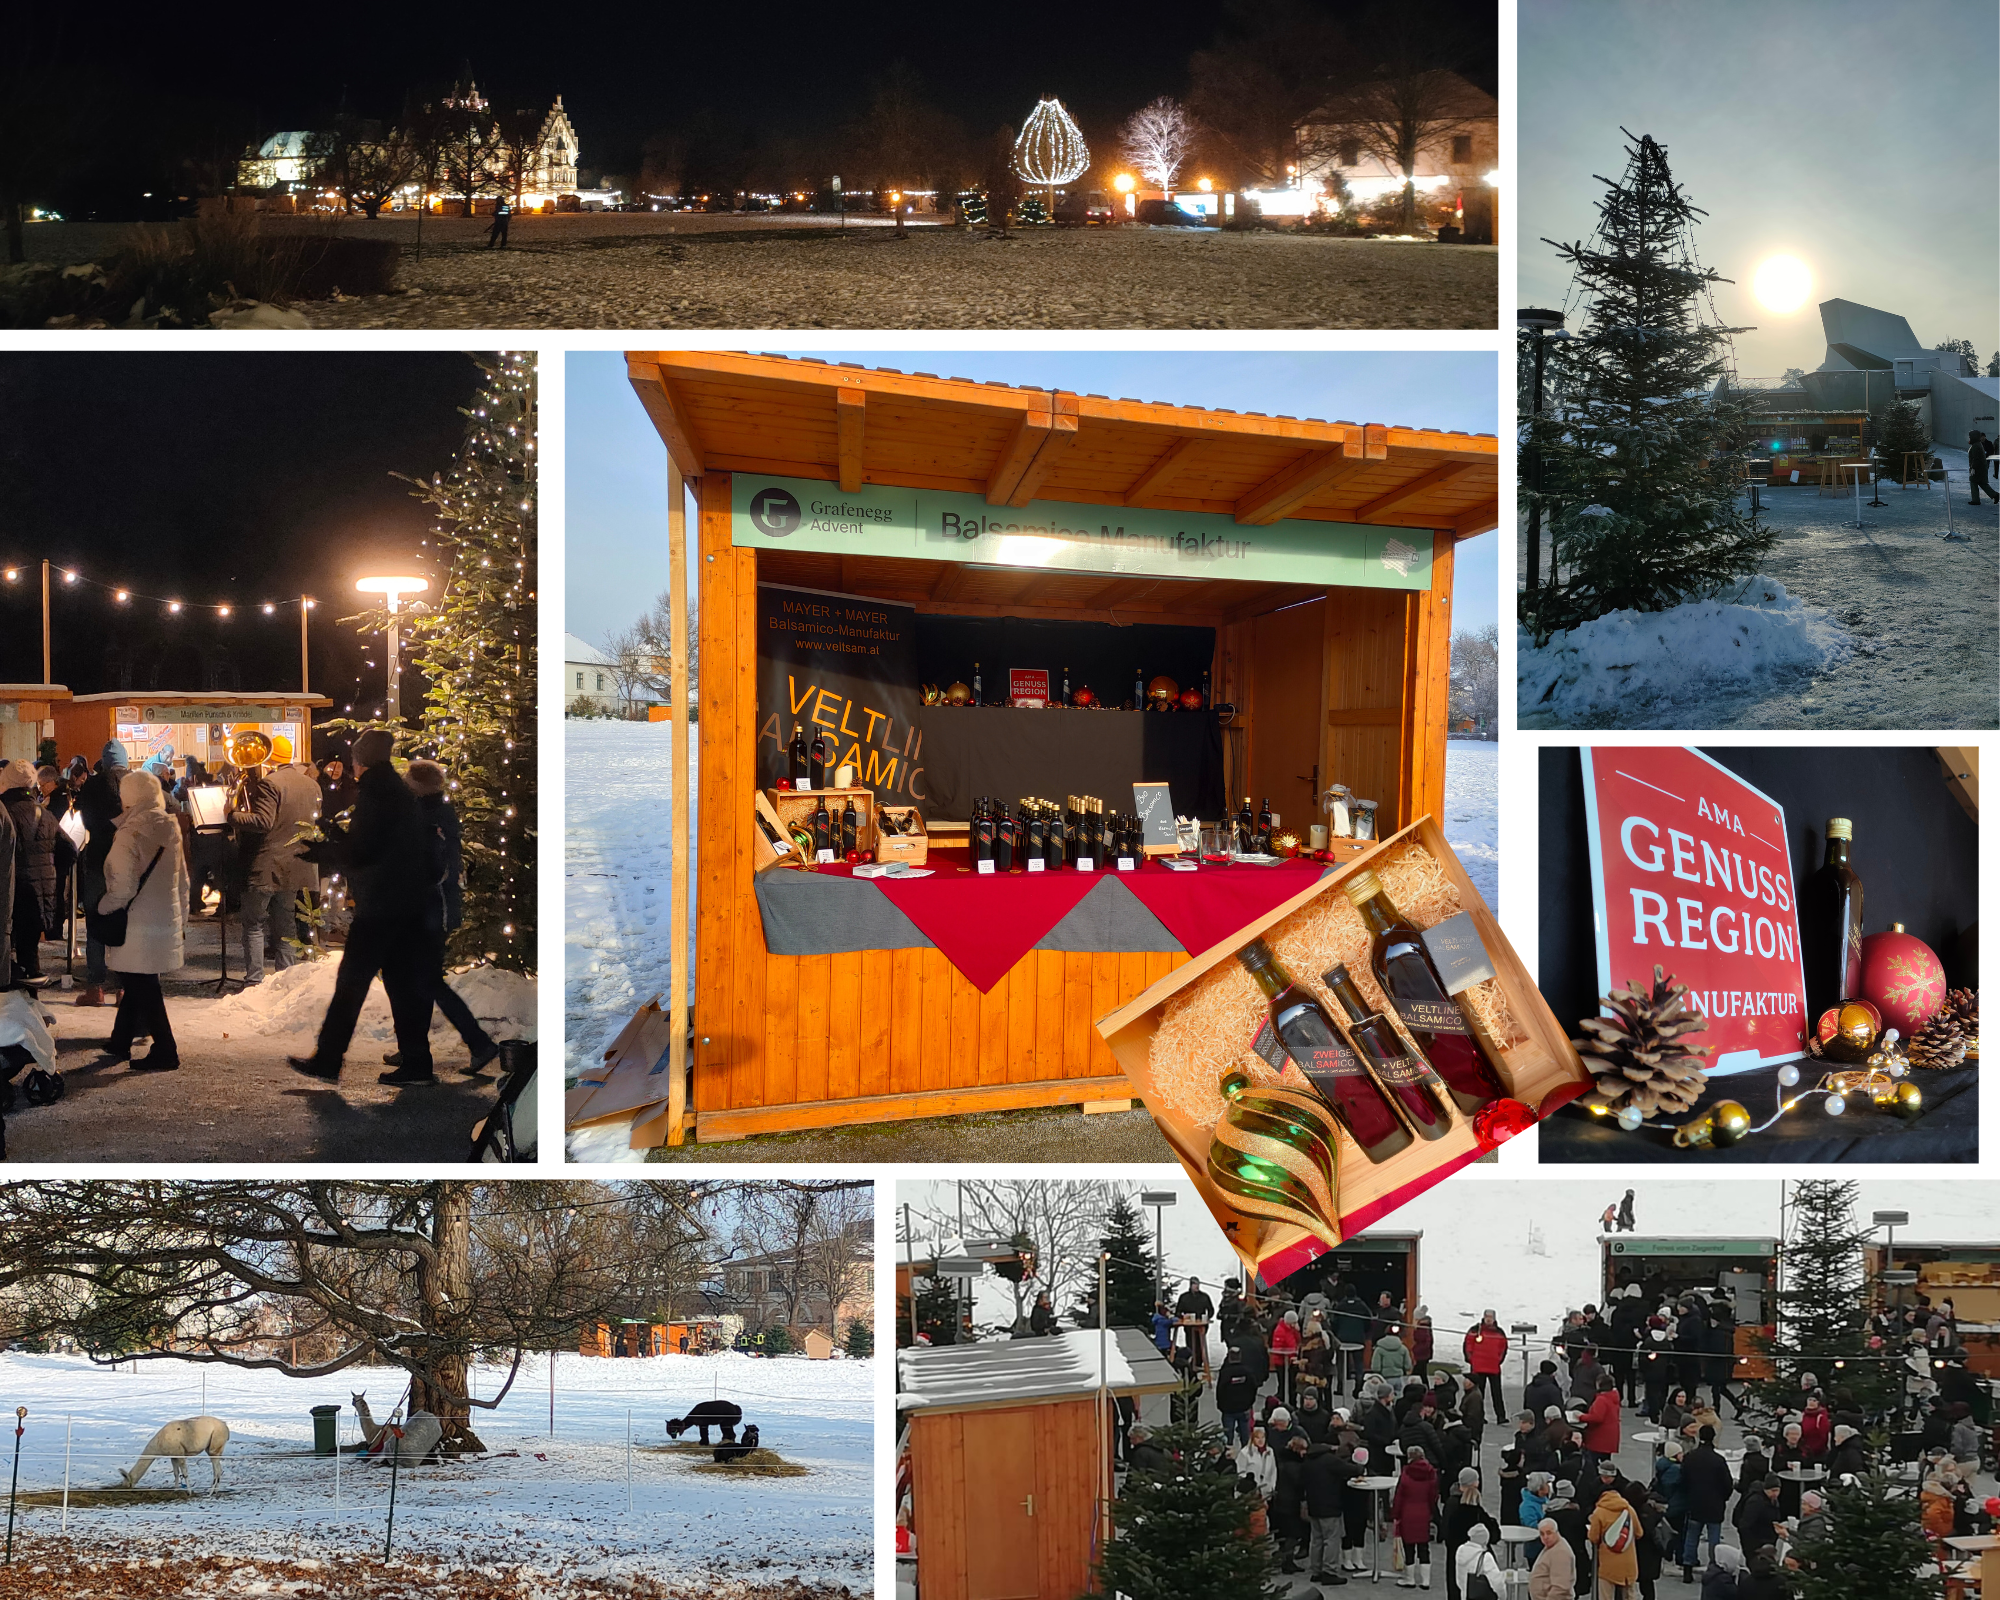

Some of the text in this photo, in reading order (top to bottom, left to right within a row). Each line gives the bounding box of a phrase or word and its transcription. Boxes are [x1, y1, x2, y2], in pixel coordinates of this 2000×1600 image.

[810, 500, 893, 523] Grafenegg
[810, 518, 864, 534] Advent
[1100, 525, 1251, 560] Manufaktur
[783, 600, 888, 625] MAYER + MAYER
[769, 616, 900, 642] Balsamico-Manufaktur
[795, 639, 880, 655] www.veltsam.at
[1013, 680, 1046, 688] GENUSS
[1697, 796, 1745, 837] AMA
[1620, 815, 1790, 912] GENUSS
[1629, 887, 1795, 963] REGION
[1679, 990, 1799, 1019] NUFAKTUR
[1399, 1011, 1462, 1025] BALSAMICO
[1298, 1058, 1355, 1069] BALSAMICO
